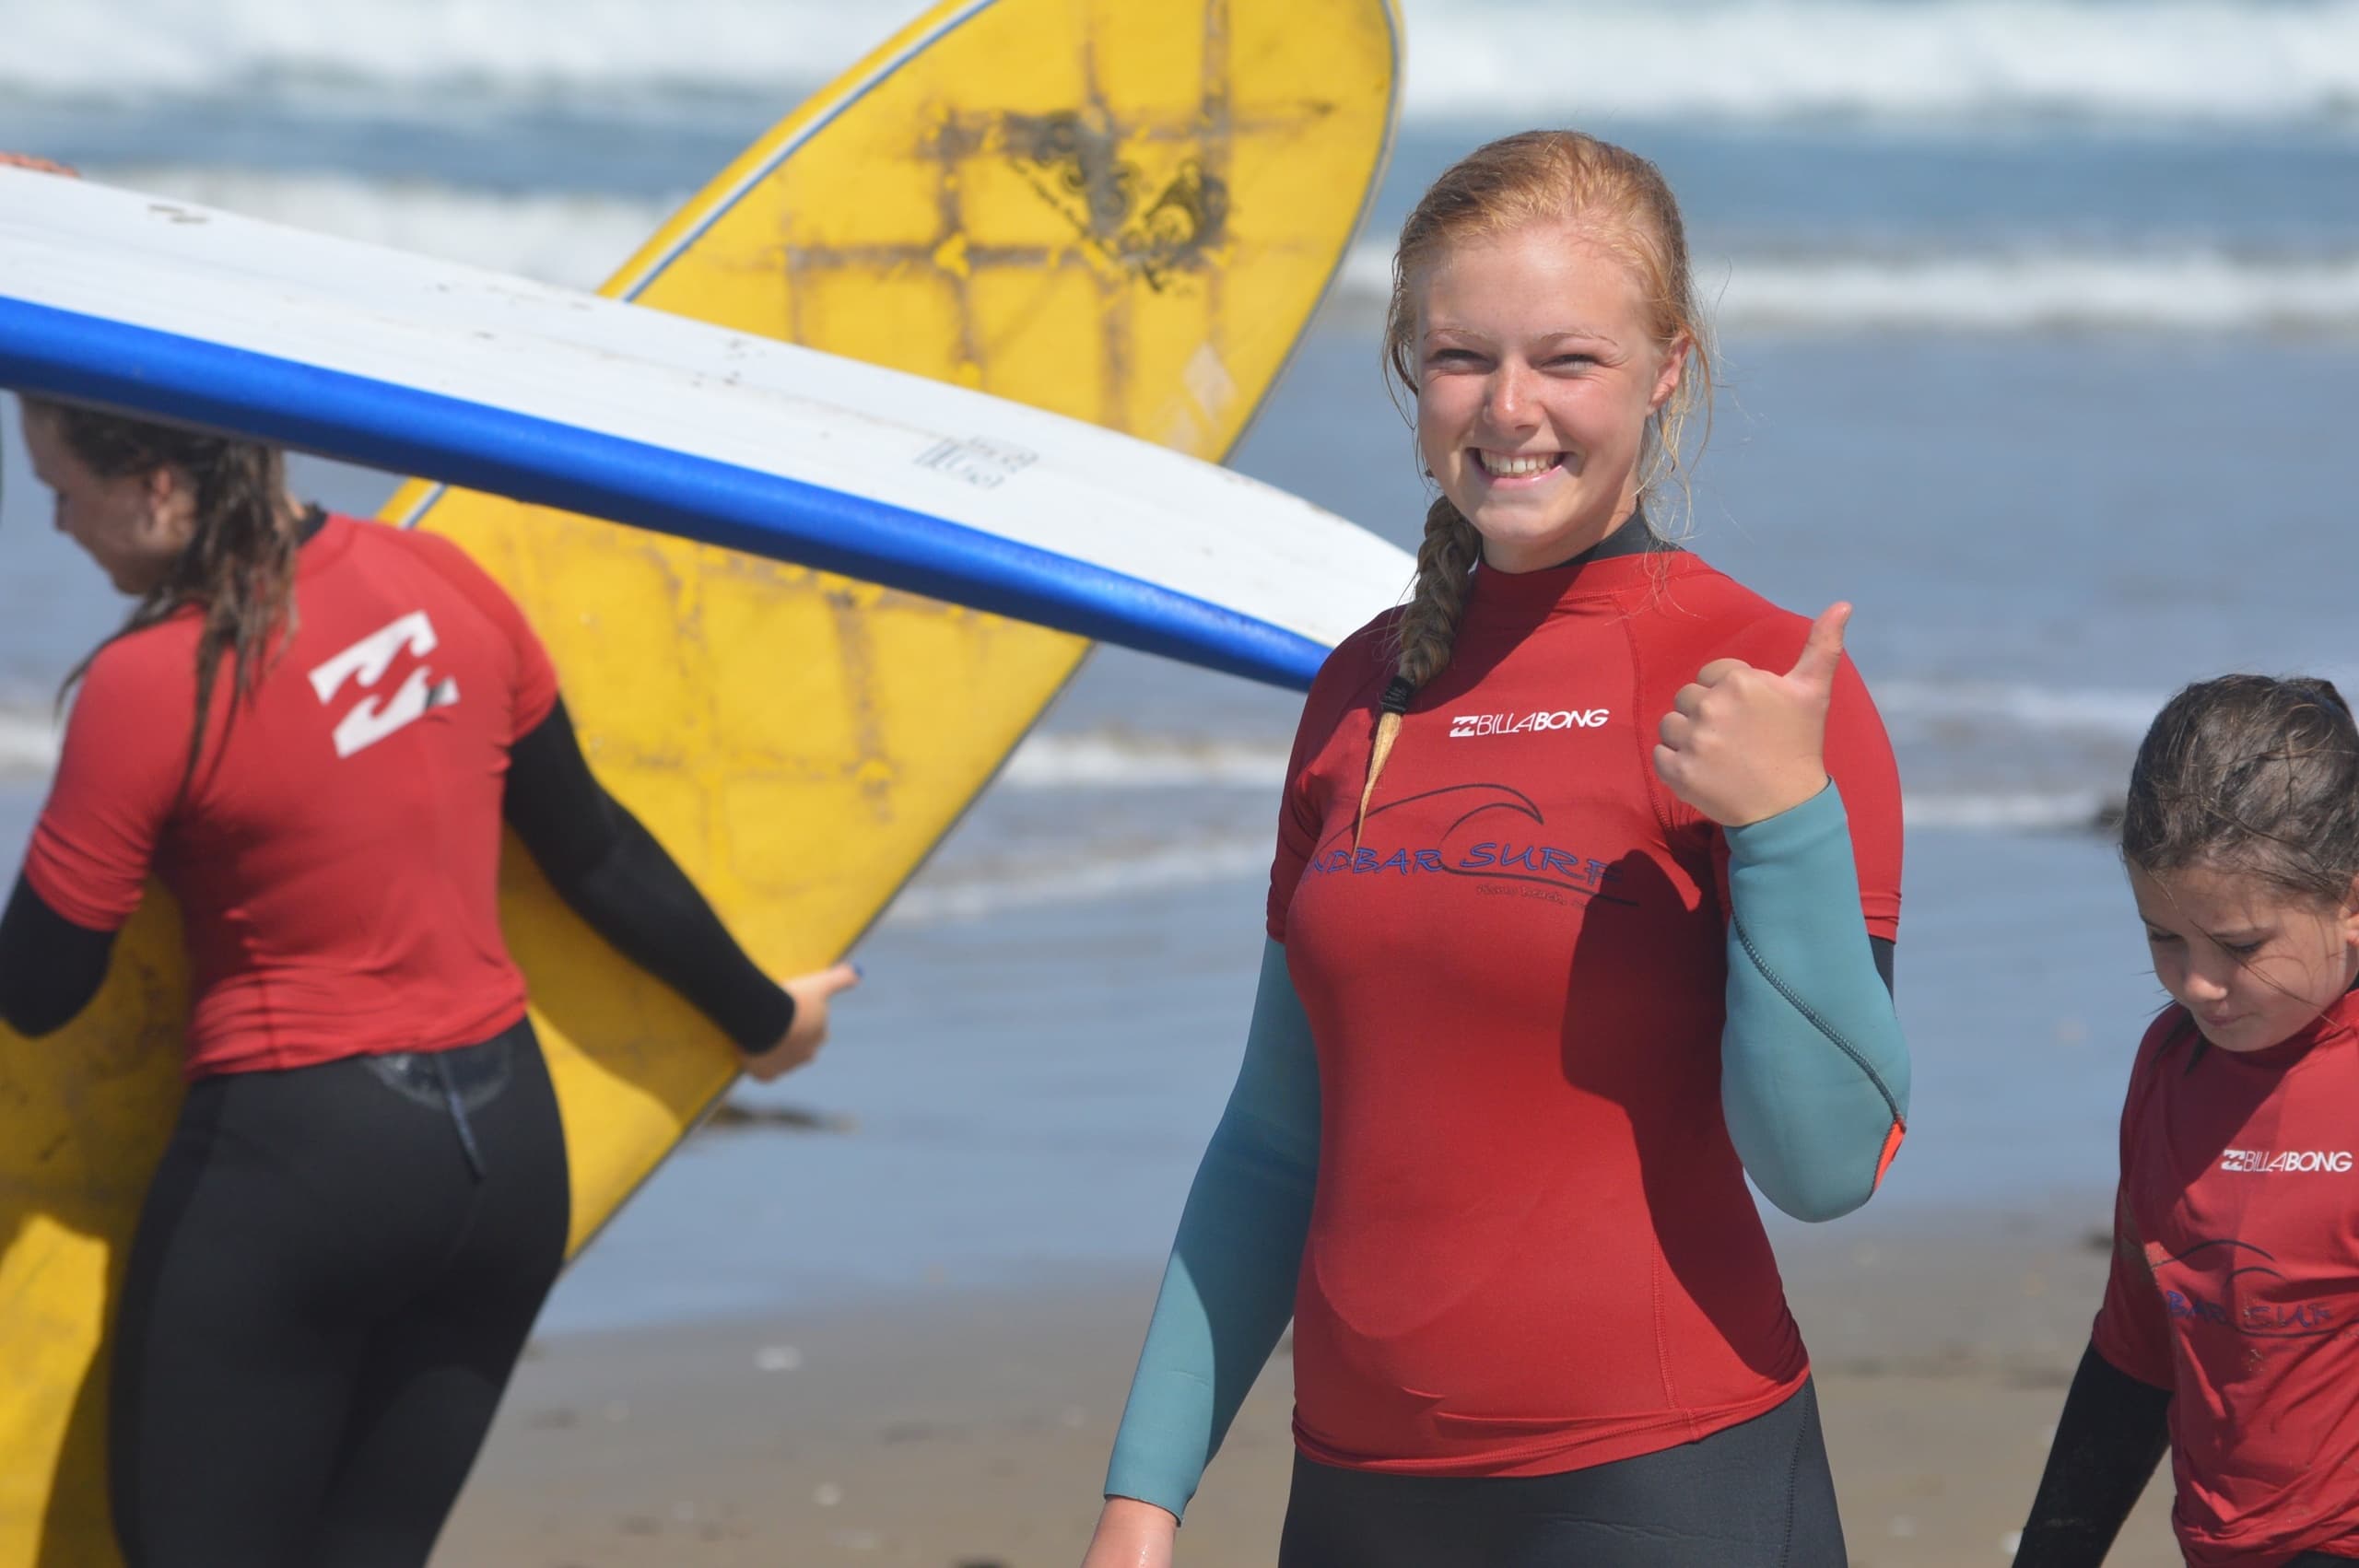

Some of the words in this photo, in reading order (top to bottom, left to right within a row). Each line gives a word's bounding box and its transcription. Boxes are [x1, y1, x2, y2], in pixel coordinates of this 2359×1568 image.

[1476, 708, 1610, 735] BILLABONG
[1309, 846, 1444, 876] NDBAR
[2243, 1151, 2353, 1173] BILLABONG
